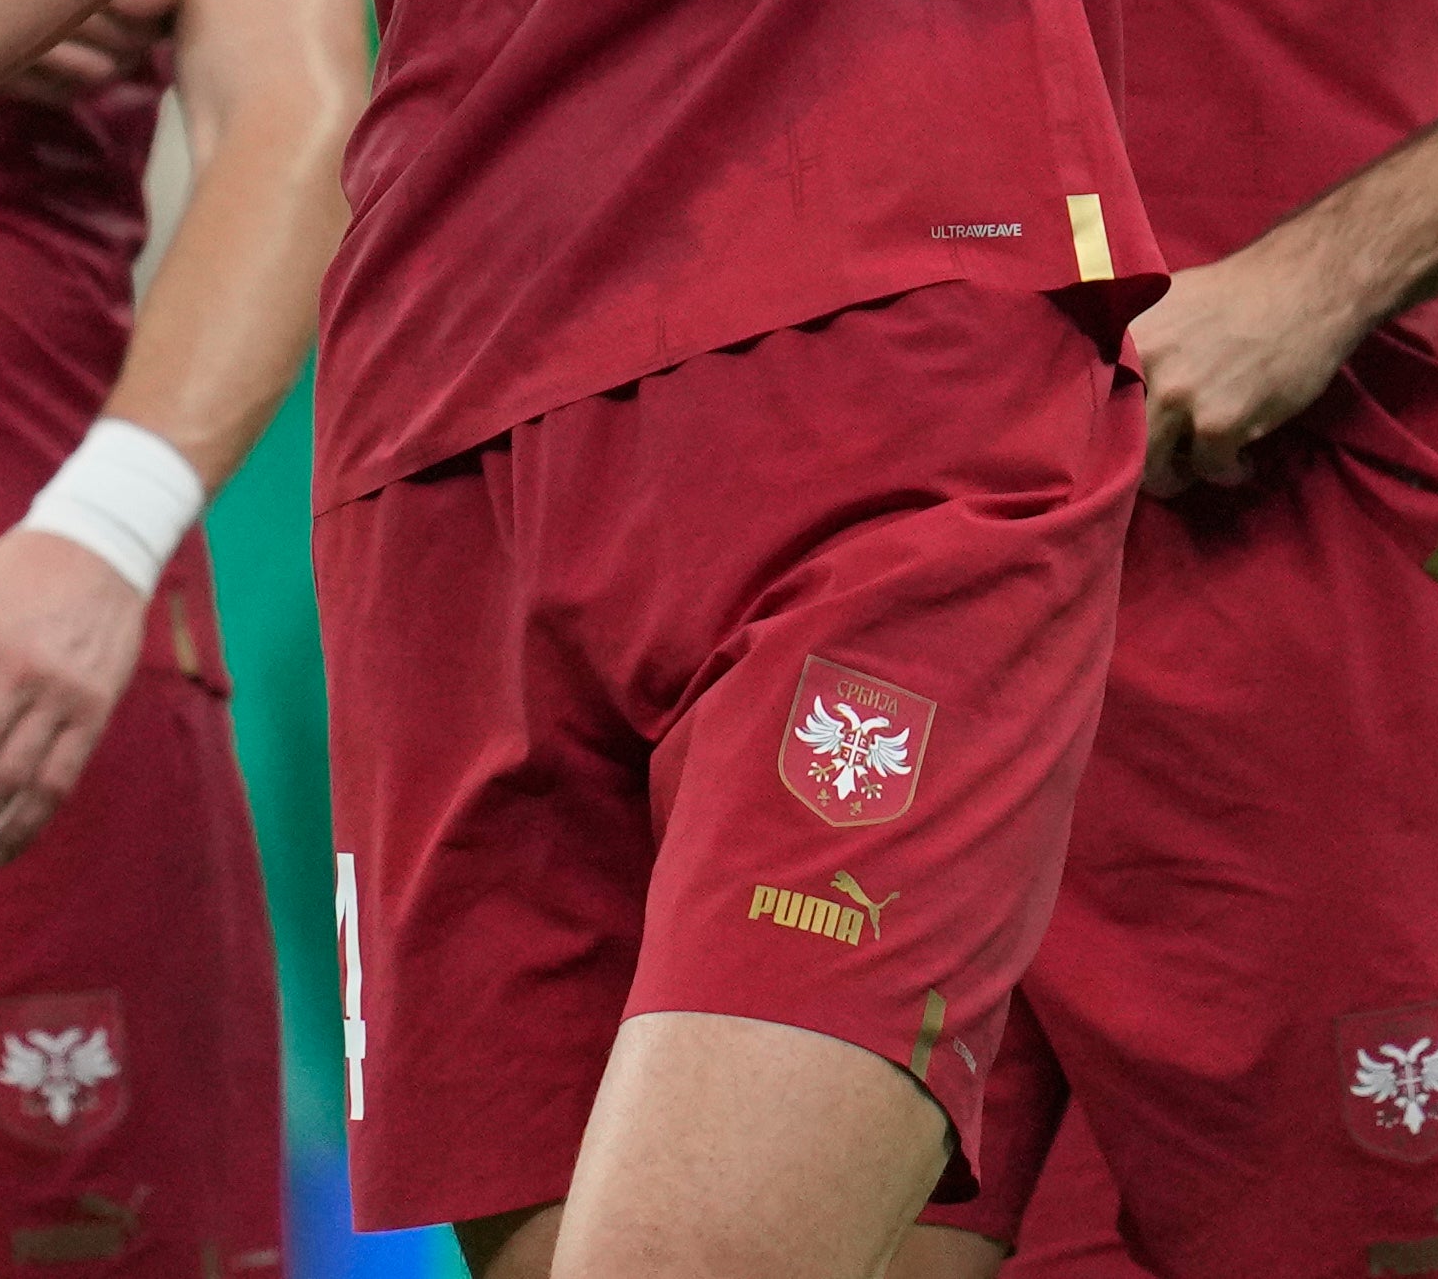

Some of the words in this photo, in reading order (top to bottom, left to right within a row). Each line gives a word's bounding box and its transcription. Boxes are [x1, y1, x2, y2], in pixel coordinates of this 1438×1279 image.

[931, 223, 1022, 239] ULTRAWEAVE
[836, 680, 898, 716] СРБИЈА
[748, 884, 865, 946] PUMA
